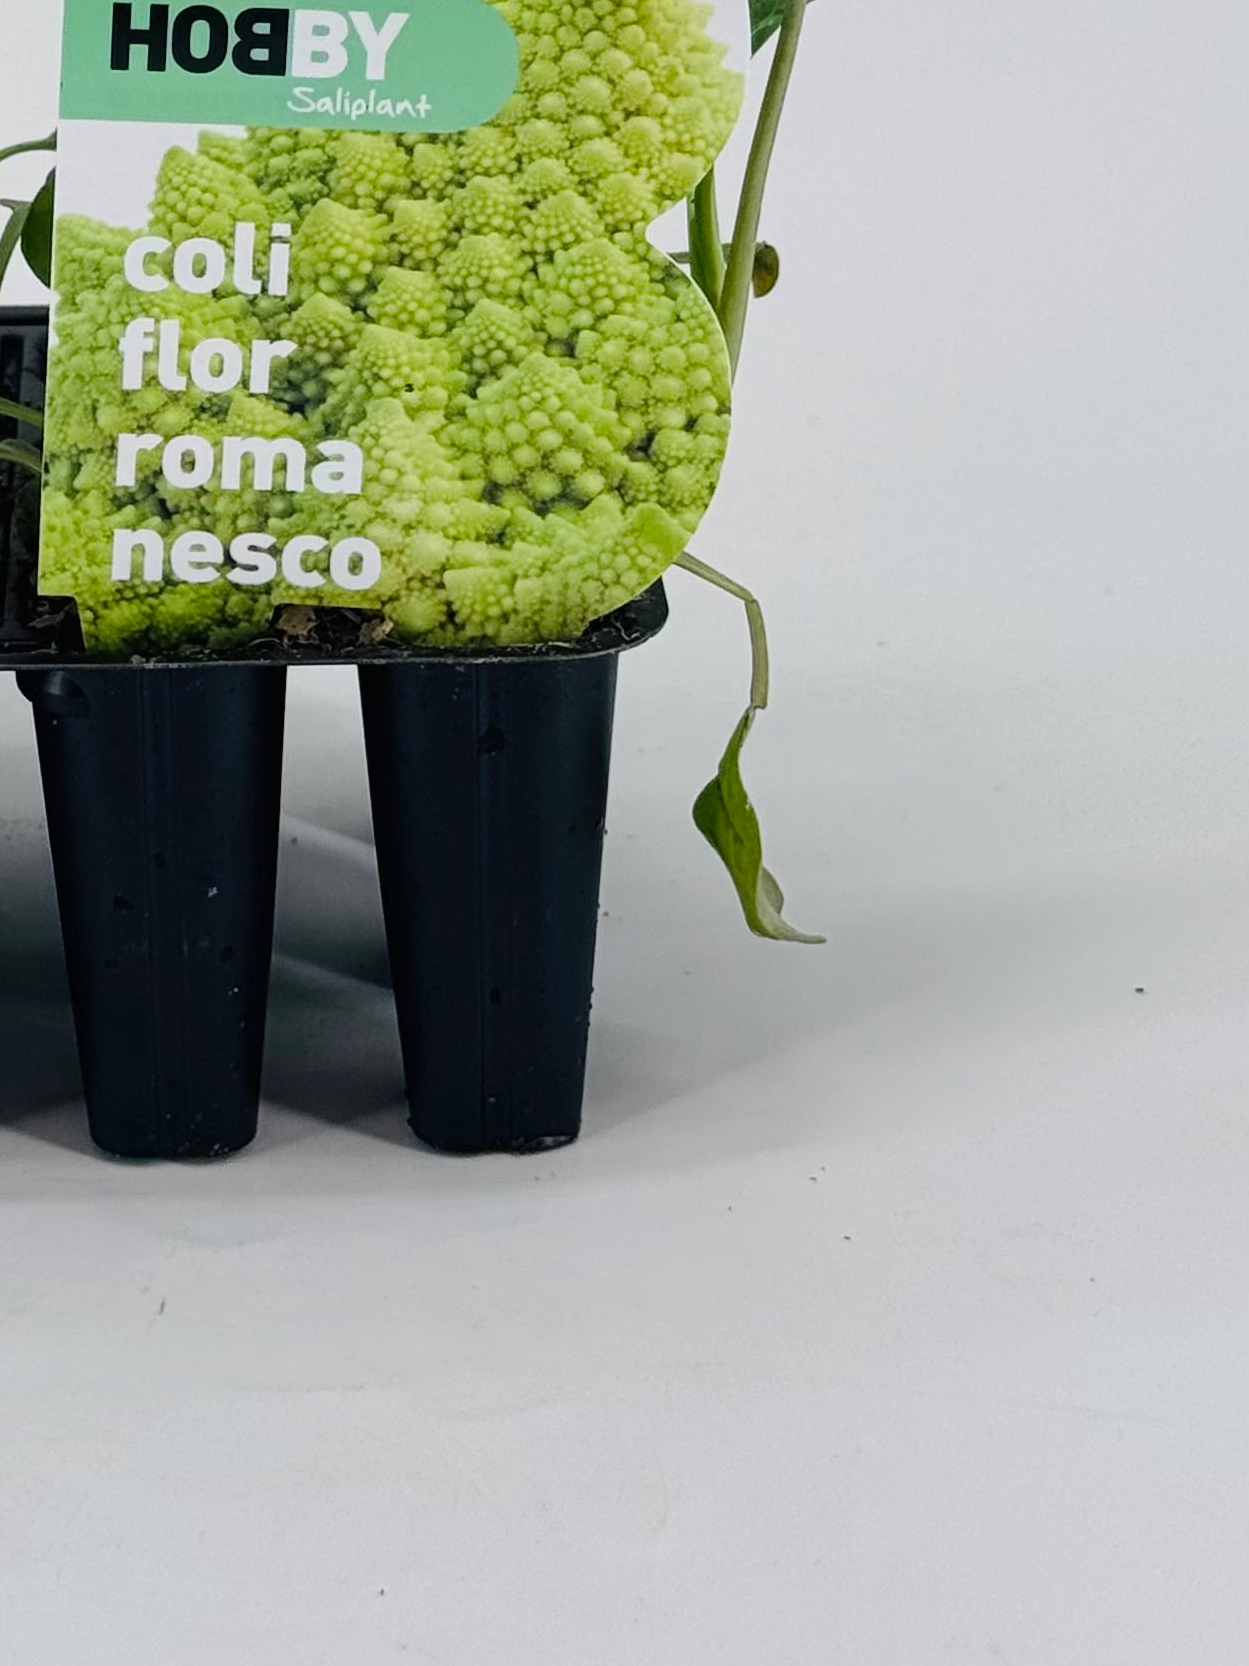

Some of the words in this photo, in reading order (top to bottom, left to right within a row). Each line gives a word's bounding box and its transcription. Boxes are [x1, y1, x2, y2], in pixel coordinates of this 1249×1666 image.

[109, 1, 410, 82] HOBBY
[286, 86, 433, 122] Saliplant
[123, 222, 292, 298] coli
[118, 317, 299, 394] flor
[114, 432, 364, 496] roma
[110, 526, 383, 591] nesco
